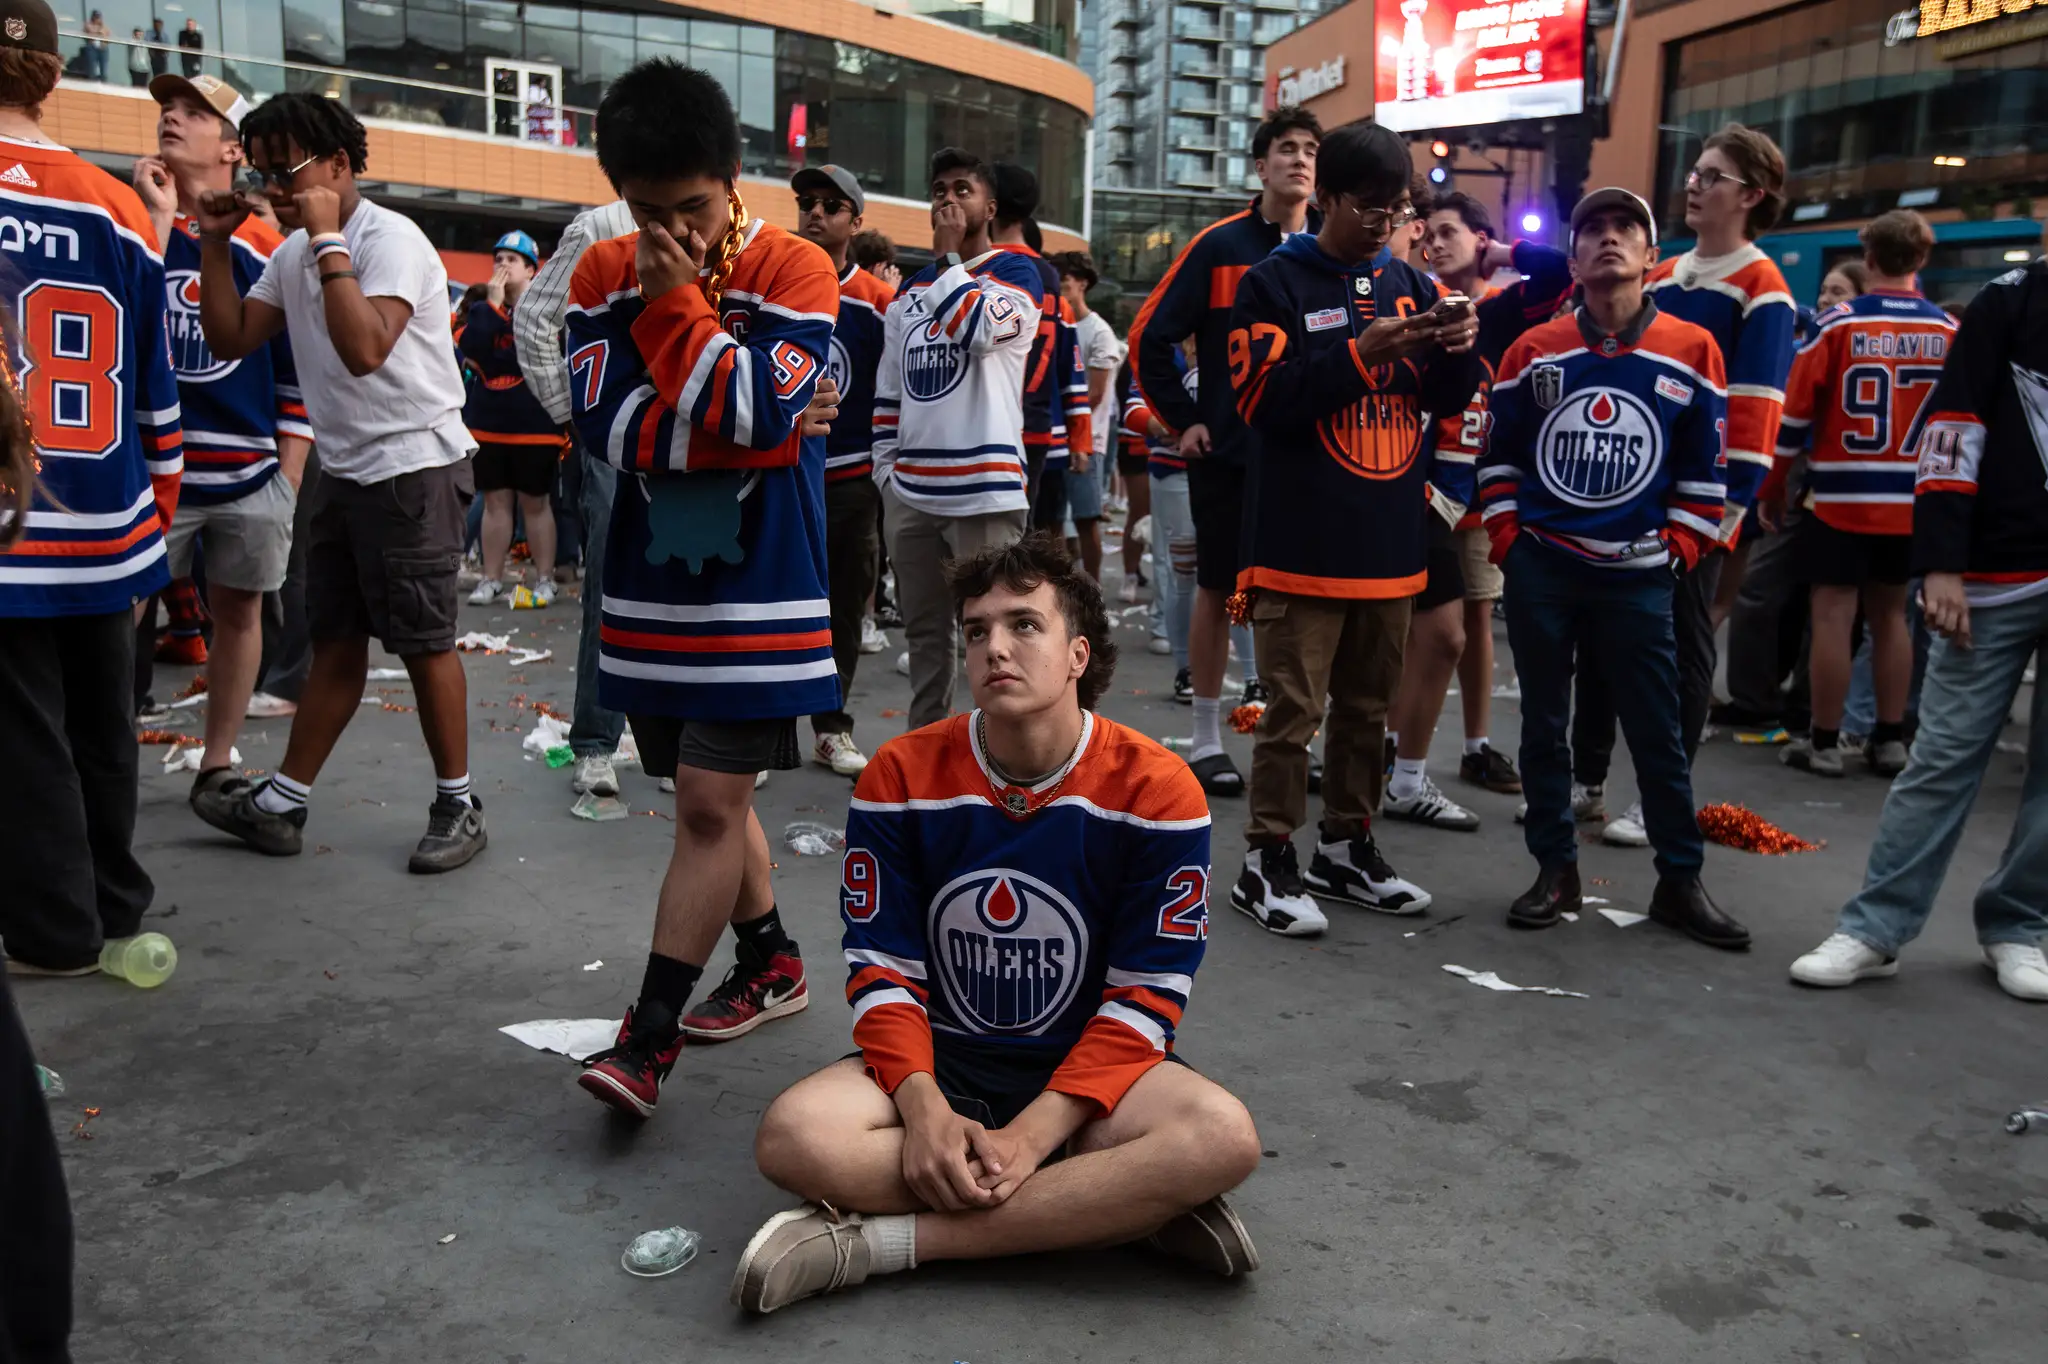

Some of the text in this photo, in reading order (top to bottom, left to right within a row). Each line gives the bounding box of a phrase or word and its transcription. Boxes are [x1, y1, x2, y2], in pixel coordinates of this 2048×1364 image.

[0, 174, 38, 188] adidas
[18, 278, 124, 460] 8
[570, 339, 610, 412] 7
[770, 340, 817, 400] 9
[907, 343, 960, 373] OILERS
[1228, 322, 1289, 391] 97
[1851, 331, 1947, 359] McDAVID
[1841, 363, 1945, 456] 97
[1554, 430, 1643, 466] OILERS
[841, 847, 880, 923] 9
[1156, 865, 1211, 941] 2
[947, 928, 1065, 984] OILERS
